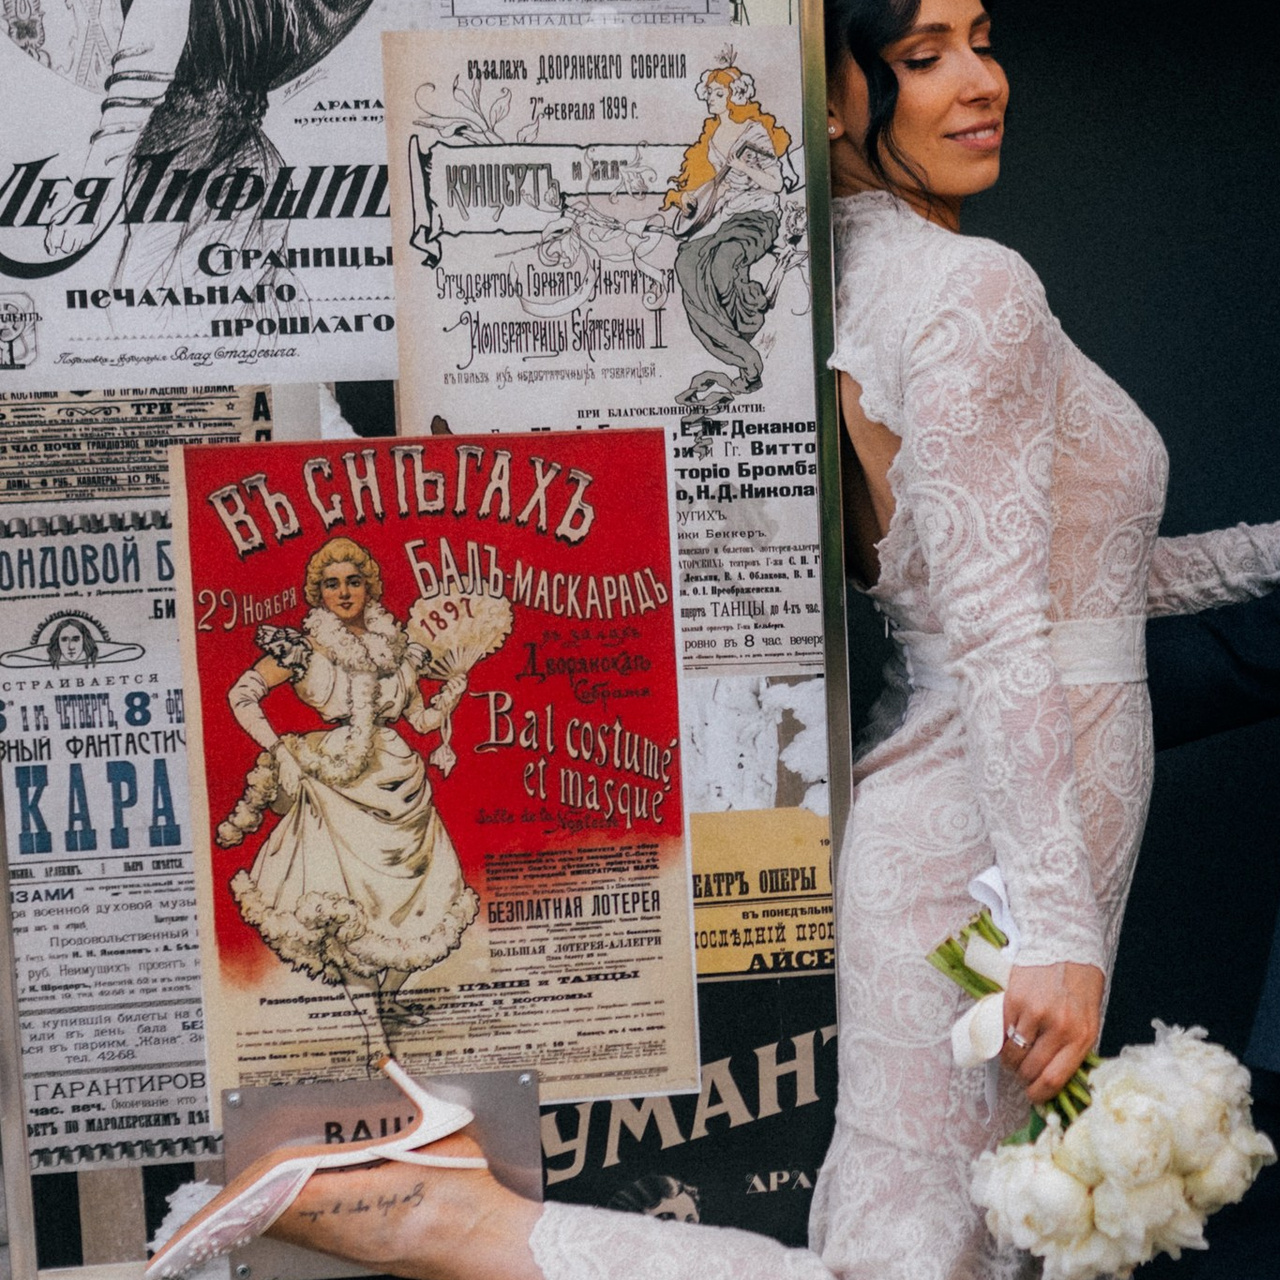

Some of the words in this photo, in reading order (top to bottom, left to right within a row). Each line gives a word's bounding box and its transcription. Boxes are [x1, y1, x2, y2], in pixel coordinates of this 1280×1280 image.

[600, 96, 627, 120] 1899
[131, 402, 173, 415] ТРИ
[740, 483, 818, 499] Никола
[197, 588, 238, 632] 29
[419, 596, 474, 642] 1897
[710, 600, 765, 618] ТАНЦЫ
[684, 640, 717, 652] ровно
[724, 639, 738, 648] въ
[744, 634, 755, 648] 8
[2, 673, 160, 692] СТРАИВАЕТСЯ
[470, 689, 555, 754] Bal
[523, 758, 547, 800] et
[15, 758, 182, 856] КАРА
[759, 865, 817, 893] ОПЕРЫ
[488, 896, 584, 924] БЕЗПЛАТНАЯ
[591, 889, 661, 917] ЛОТЕРЕЯ
[694, 920, 787, 951] ОСЛѢДНІЙ
[557, 969, 641, 985] ТАНЦЫ
[34, 1072, 206, 1102] ГАРАНТИРОВ
[540, 1024, 838, 1187] УМАН
